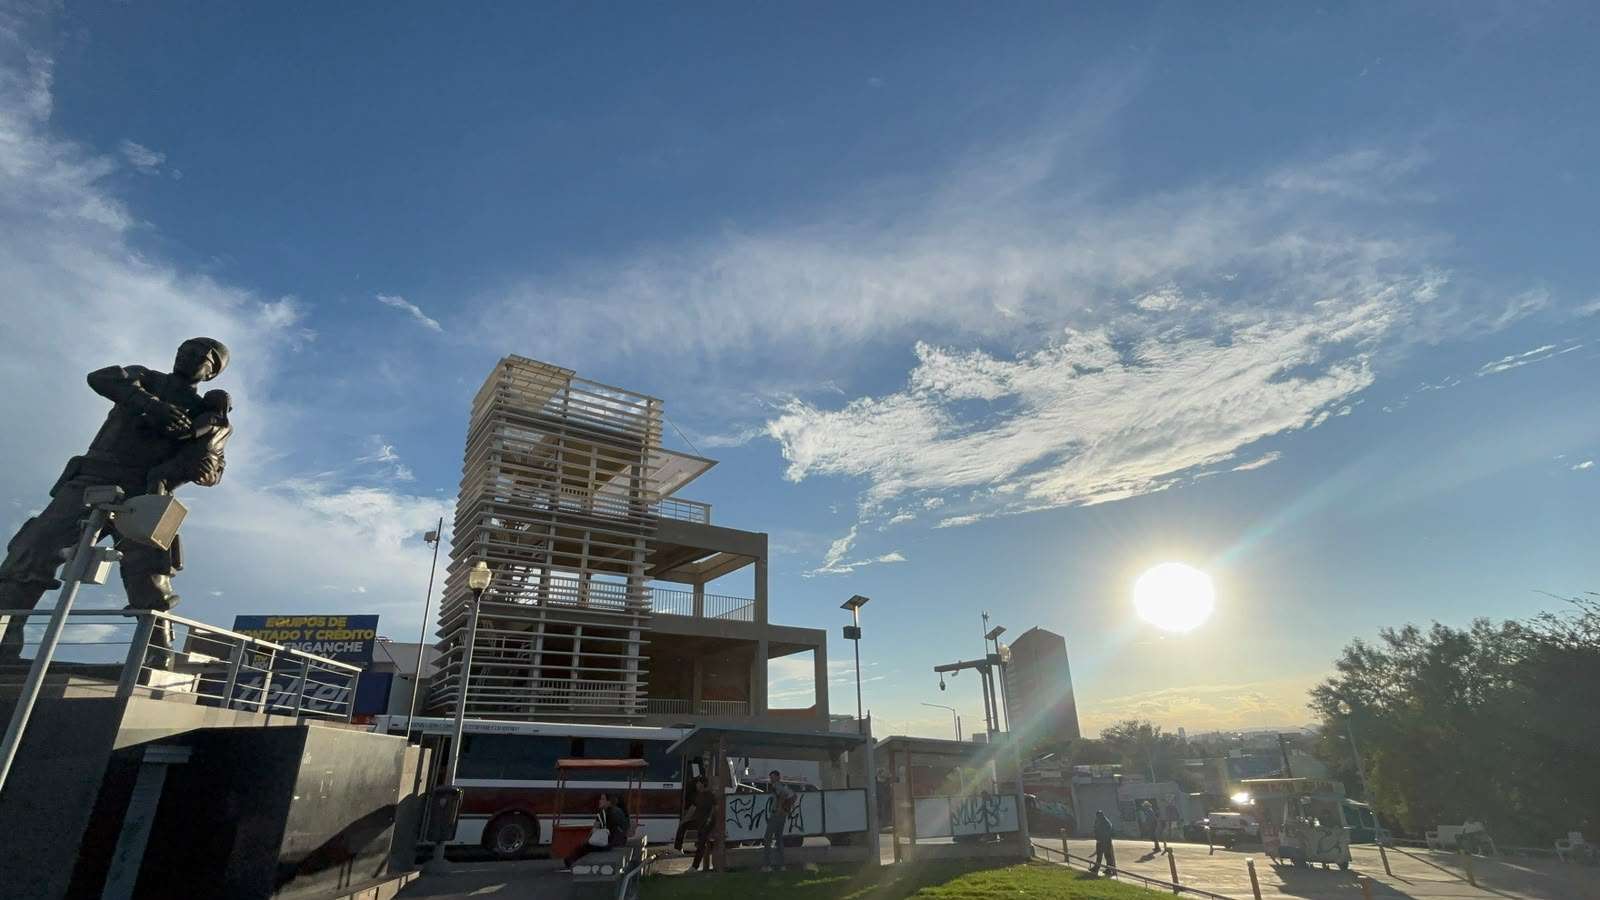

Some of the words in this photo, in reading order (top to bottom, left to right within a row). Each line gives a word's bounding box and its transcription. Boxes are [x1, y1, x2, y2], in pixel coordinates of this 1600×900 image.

[266, 617, 326, 627] EQUIPOS
[328, 616, 347, 627] DE
[304, 630, 314, 640] Y
[315, 628, 375, 640] CRÉDITO
